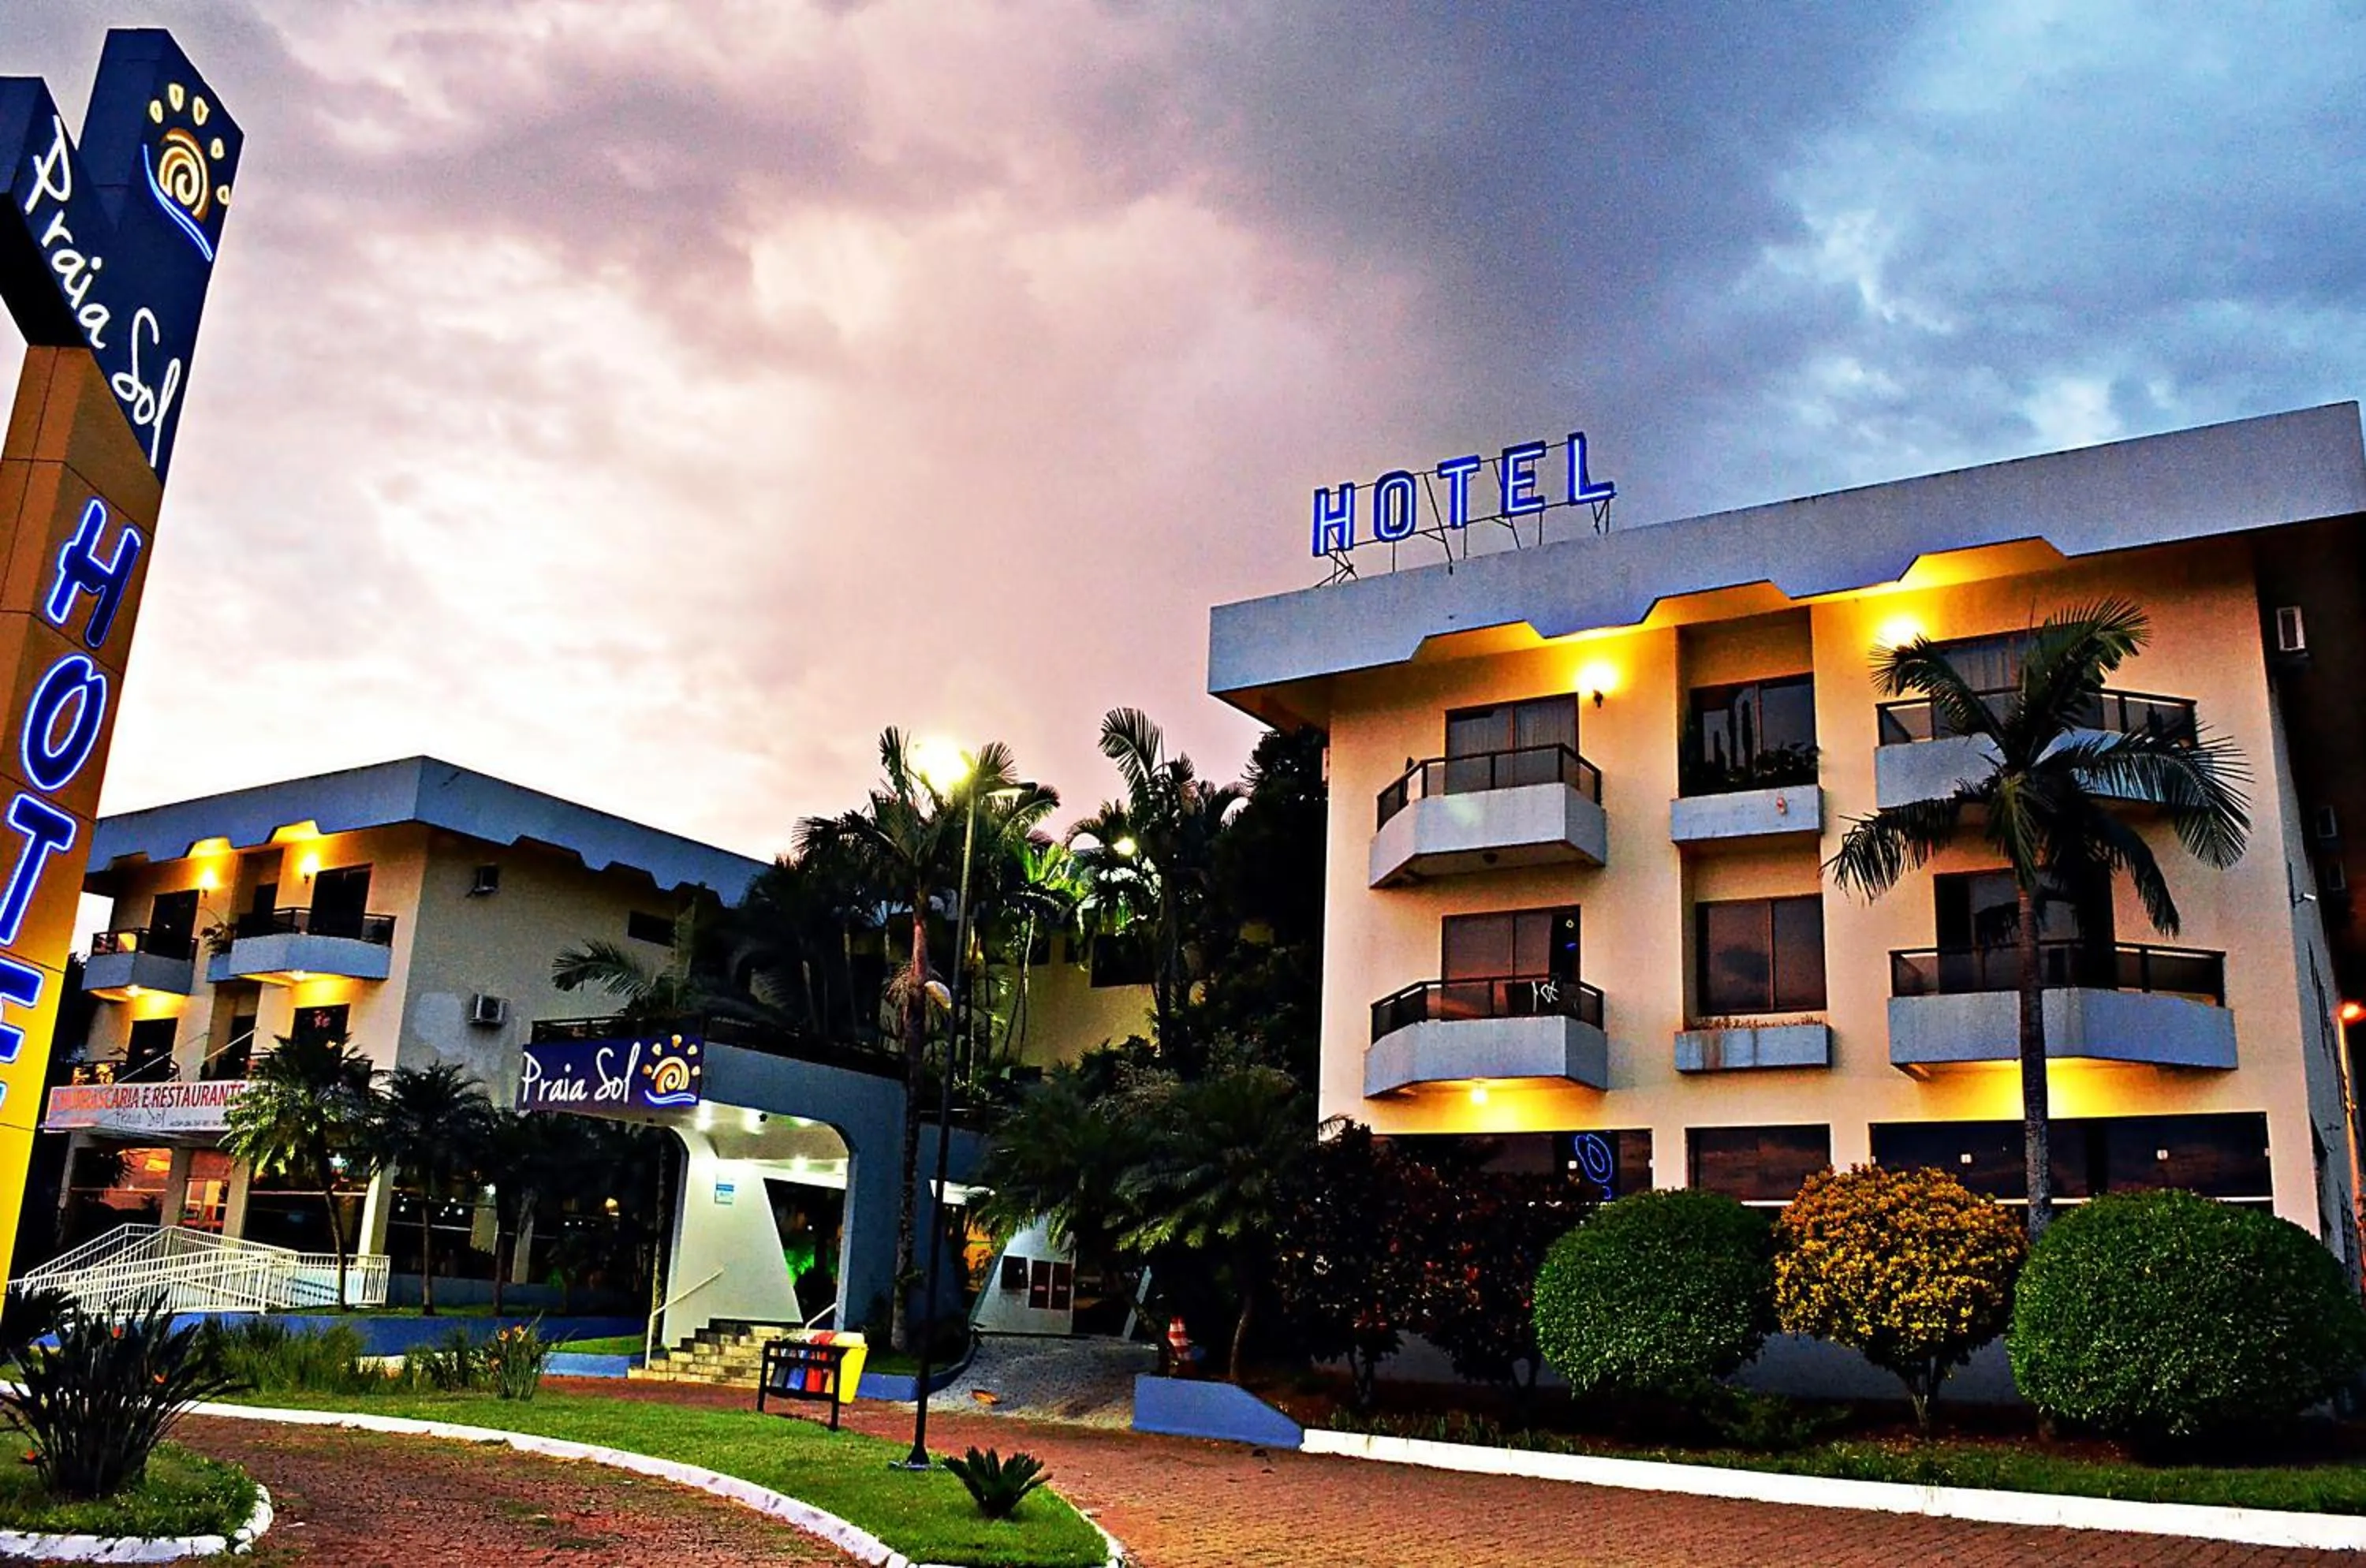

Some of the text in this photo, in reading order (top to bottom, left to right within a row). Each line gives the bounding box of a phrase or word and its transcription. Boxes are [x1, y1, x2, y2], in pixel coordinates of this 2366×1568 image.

[26, 114, 181, 468] Praia Sol
[1312, 431, 1618, 557] HOTEL
[142, 1086, 150, 1107] E
[152, 1084, 245, 1108] RESTAURANTE
[521, 1042, 641, 1103] Praia Sol
